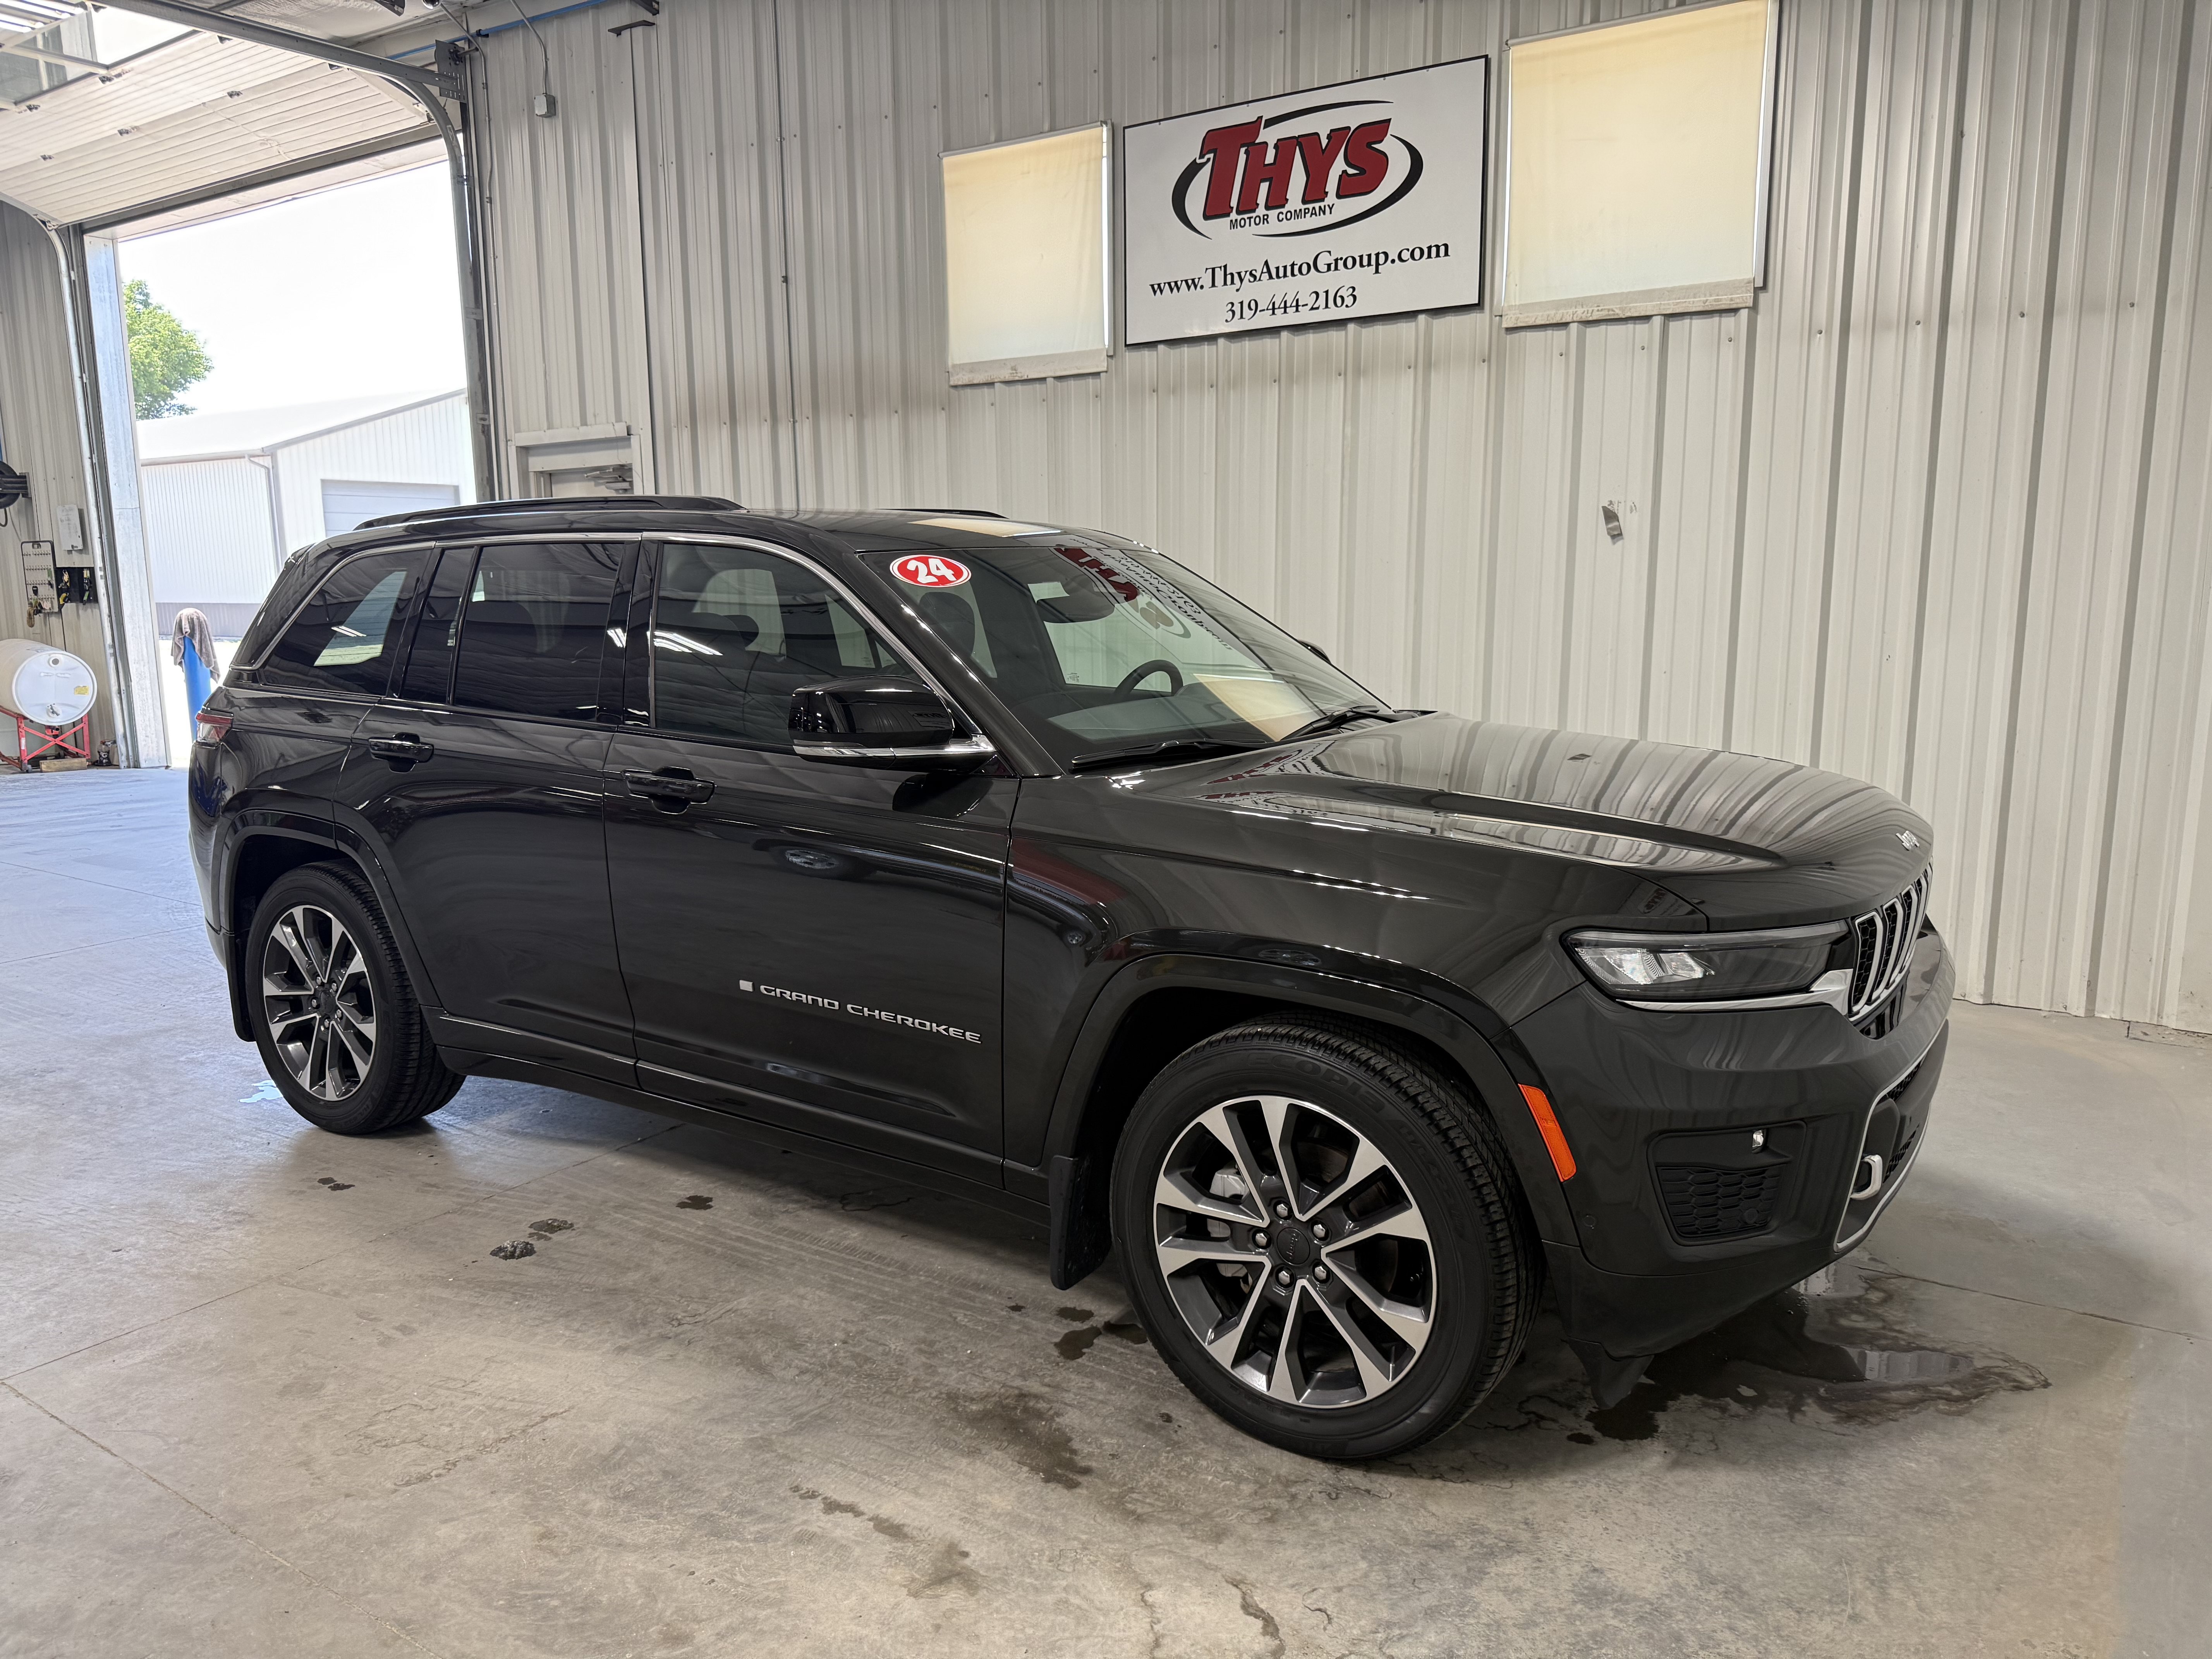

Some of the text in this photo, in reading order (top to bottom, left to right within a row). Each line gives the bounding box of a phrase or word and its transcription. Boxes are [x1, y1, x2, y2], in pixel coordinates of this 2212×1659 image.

[1199, 115, 1392, 221] THYS
[1230, 203, 1335, 230] MOTOR COMPANY
[1149, 243, 1450, 297] www.ThysAutoGroup.com
[1225, 286, 1357, 323] 319-444-2163
[907, 558, 957, 584] 24
[1896, 830, 1920, 850] Jeep
[760, 985, 981, 1044] GRAND CHEROKEE
